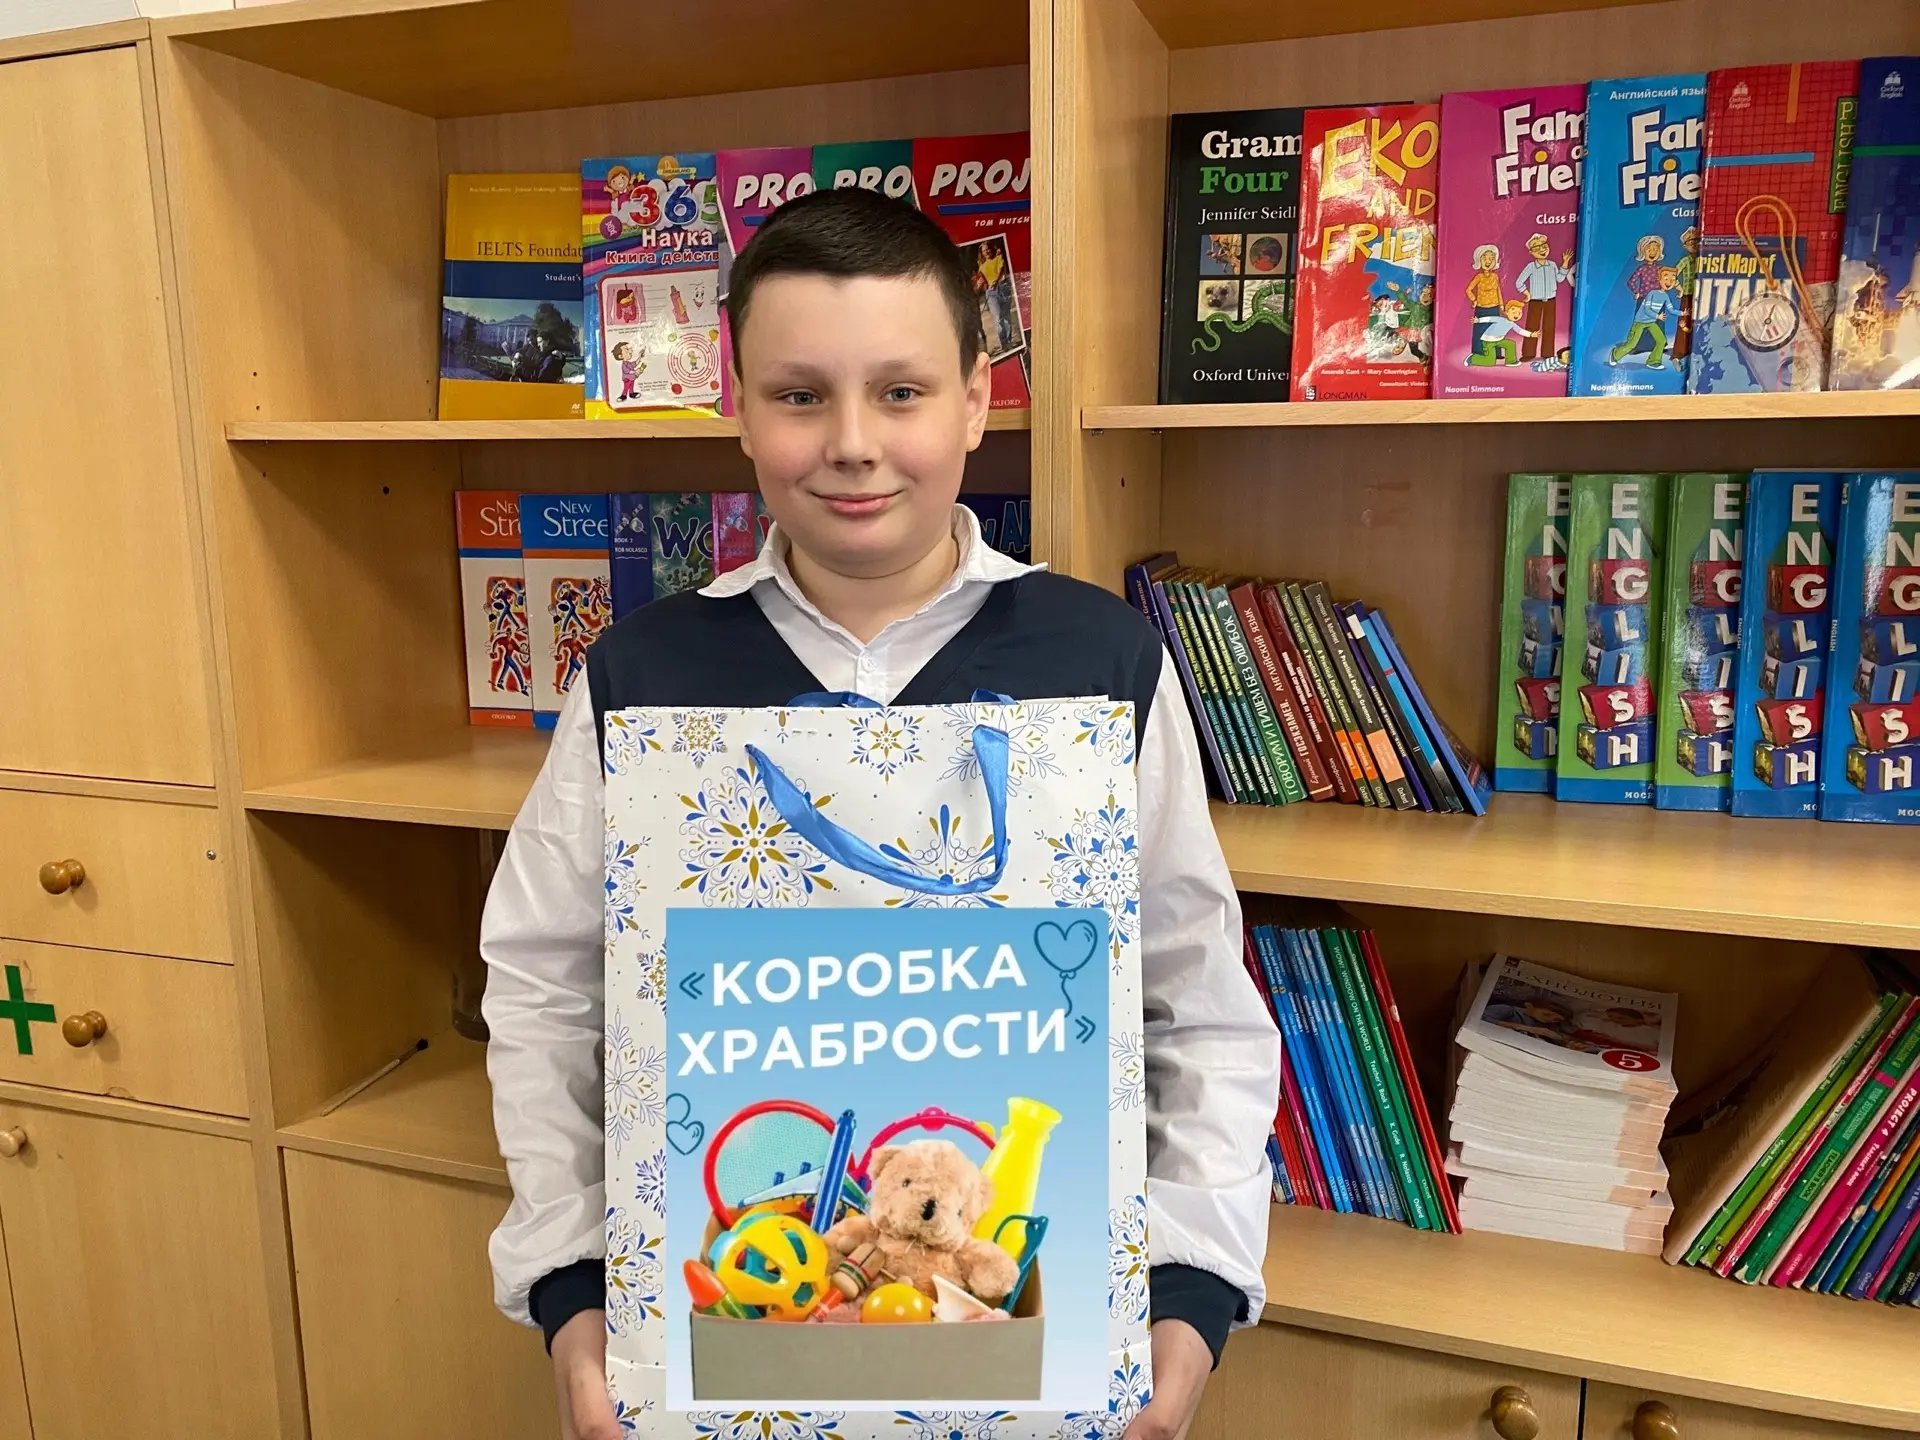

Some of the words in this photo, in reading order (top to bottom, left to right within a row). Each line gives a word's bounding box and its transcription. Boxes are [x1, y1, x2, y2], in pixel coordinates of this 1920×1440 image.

[1609, 88, 1679, 101] Английский
[1201, 129, 1303, 159] Gram
[1320, 117, 1439, 202] EKO
[929, 158, 1030, 197] PROJ
[1198, 166, 1289, 194] Four
[734, 172, 813, 208] PRO
[1367, 188, 1436, 218] AND
[975, 219, 994, 227] TOM
[999, 216, 1031, 226] HUTCH
[1198, 207, 1258, 225] Jennifer
[1260, 205, 1297, 220] Seidl
[1536, 213, 1566, 225] Class
[477, 241, 523, 256] IELTS
[642, 228, 713, 251] Наука
[606, 250, 656, 265] Книга
[662, 248, 719, 265] действ
[1727, 254, 1757, 277] Map
[545, 273, 581, 282] Student's
[1193, 369, 1243, 382] Oxford
[1590, 383, 1617, 391] Naomi
[1618, 383, 1654, 391] Simmons
[1319, 391, 1367, 400] LONGMAN
[1445, 385, 1469, 393] Naomi
[1470, 385, 1505, 393] Simmons
[543, 507, 608, 537] Stree
[1243, 607, 1260, 633] ЯЗЫК
[1607, 482, 1649, 767] ENGLISH
[1220, 614, 1250, 665] ОШИБОК
[1784, 484, 1828, 785] ENGLISH
[1829, 619, 1837, 651] ENGLISH
[1879, 484, 1920, 791] ENGLISH
[1252, 634, 1284, 693] АНГЛИЙСКИЙ
[1241, 665, 1258, 687] БЕЗ
[1304, 654, 1319, 679] Practical
[1314, 678, 1327, 699] English
[1322, 698, 1337, 723] Grammar
[1339, 654, 1354, 679] Practical
[1349, 678, 1363, 700] English
[1357, 699, 1373, 725] Grammar
[1249, 687, 1274, 728] ПИШЕМ
[1265, 728, 1276, 737] И
[1267, 739, 1299, 796] ГОВОРИМ
[1358, 785, 1370, 803] Oxford
[1373, 785, 1386, 803] Oxford
[1396, 786, 1408, 804] Oxford
[1820, 783, 1826, 791] 2
[1332, 946, 1345, 969] WOW!
[1340, 970, 1355, 1001] WINDOW
[1350, 1001, 1359, 1013] ON
[1354, 1013, 1363, 1026] THE
[1358, 1026, 1372, 1051] WORLD
[1618, 1053, 1643, 1069] 5
[1368, 1060, 1382, 1087] Teacher's
[1377, 1088, 1388, 1103] Book
[1885, 1086, 1918, 1129] PROJECT
[1390, 1129, 1401, 1145] Gude
[1879, 1126, 1891, 1137] 4
[1400, 1160, 1413, 1183] Nolasco
[1811, 1150, 1838, 1183] TEACHER'S
[1329, 1176, 1340, 1202] OXFORD
[1337, 1176, 1349, 1202] OXFORD
[1368, 1180, 1380, 1207] OXFORD
[1800, 1180, 1817, 1200] BOOK
[1412, 1197, 1425, 1219] Oxford
[1783, 1251, 1804, 1276] OXFORD
[1856, 1270, 1873, 1292] Oxford
[1895, 1270, 1917, 1296] OXFORD
